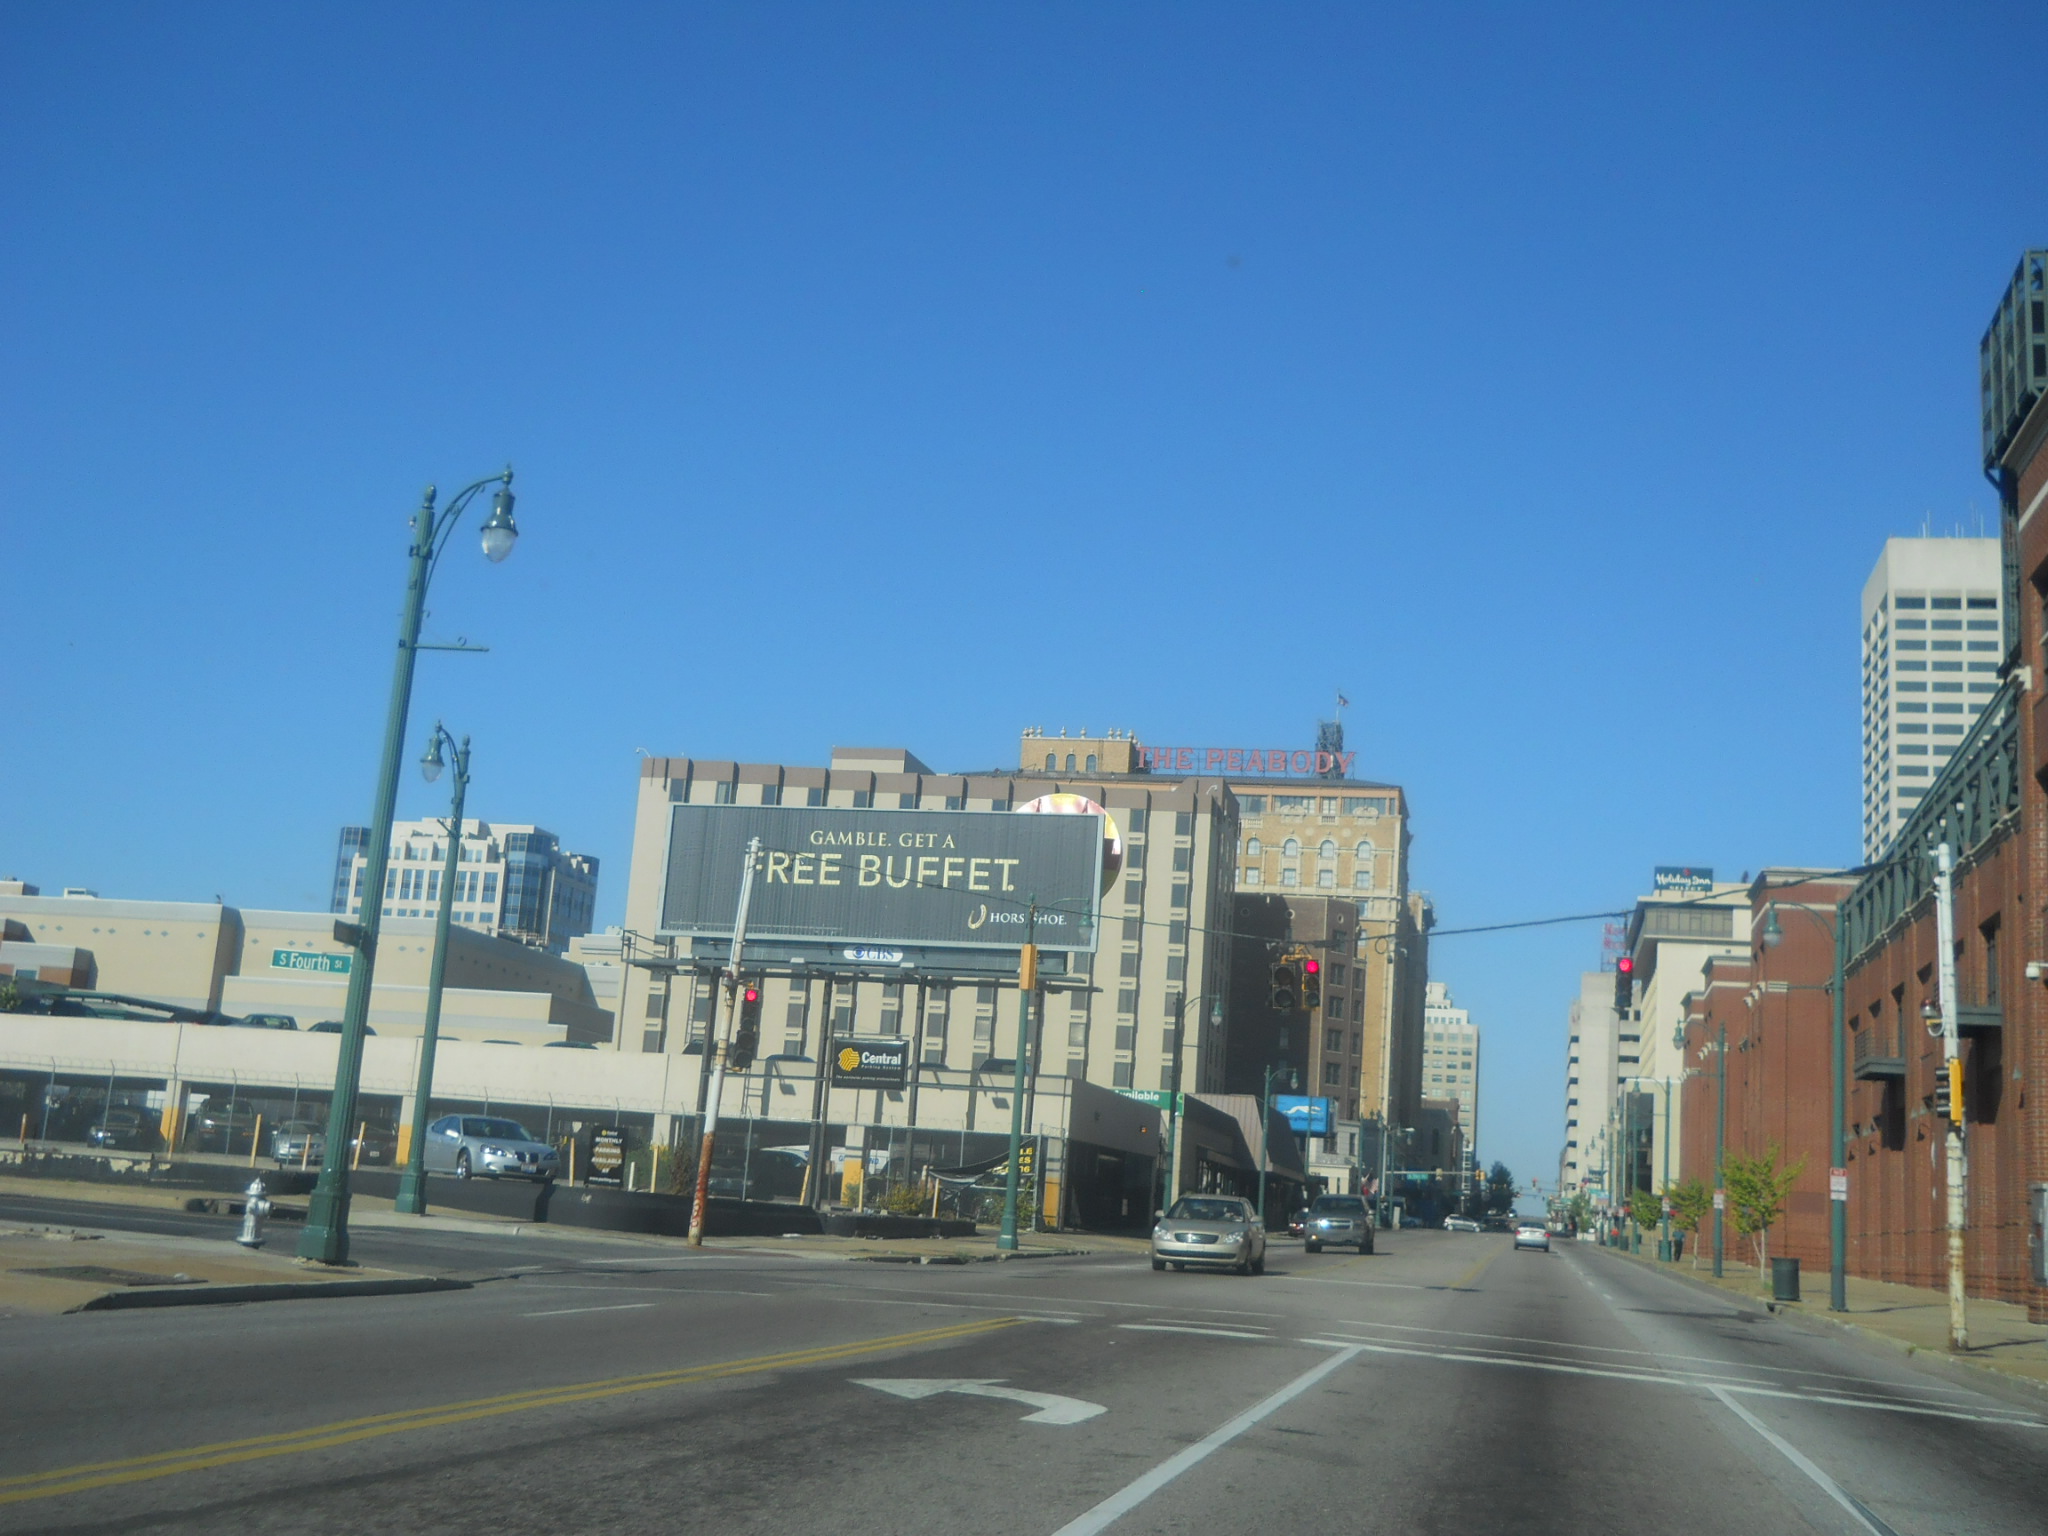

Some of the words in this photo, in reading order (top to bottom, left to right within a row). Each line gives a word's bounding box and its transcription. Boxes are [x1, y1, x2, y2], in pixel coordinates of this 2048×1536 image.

[1137, 747, 1193, 769] THE
[1205, 748, 1355, 773] PEABODY
[810, 830, 891, 847] GAMBLE.
[899, 832, 937, 848] GET
[941, 834, 955, 848] A
[859, 854, 1019, 891] BUFFET.
[1656, 873, 1691, 886] Holiday
[1692, 875, 1711, 885] Inn
[990, 912, 1067, 925] HORSSHOE.
[867, 947, 894, 960] CBS
[280, 952, 287, 966] S
[289, 952, 330, 971] Fourth
[334, 960, 343, 969] St
[861, 1051, 902, 1065] Central
[1115, 1089, 1159, 1101] ailable
